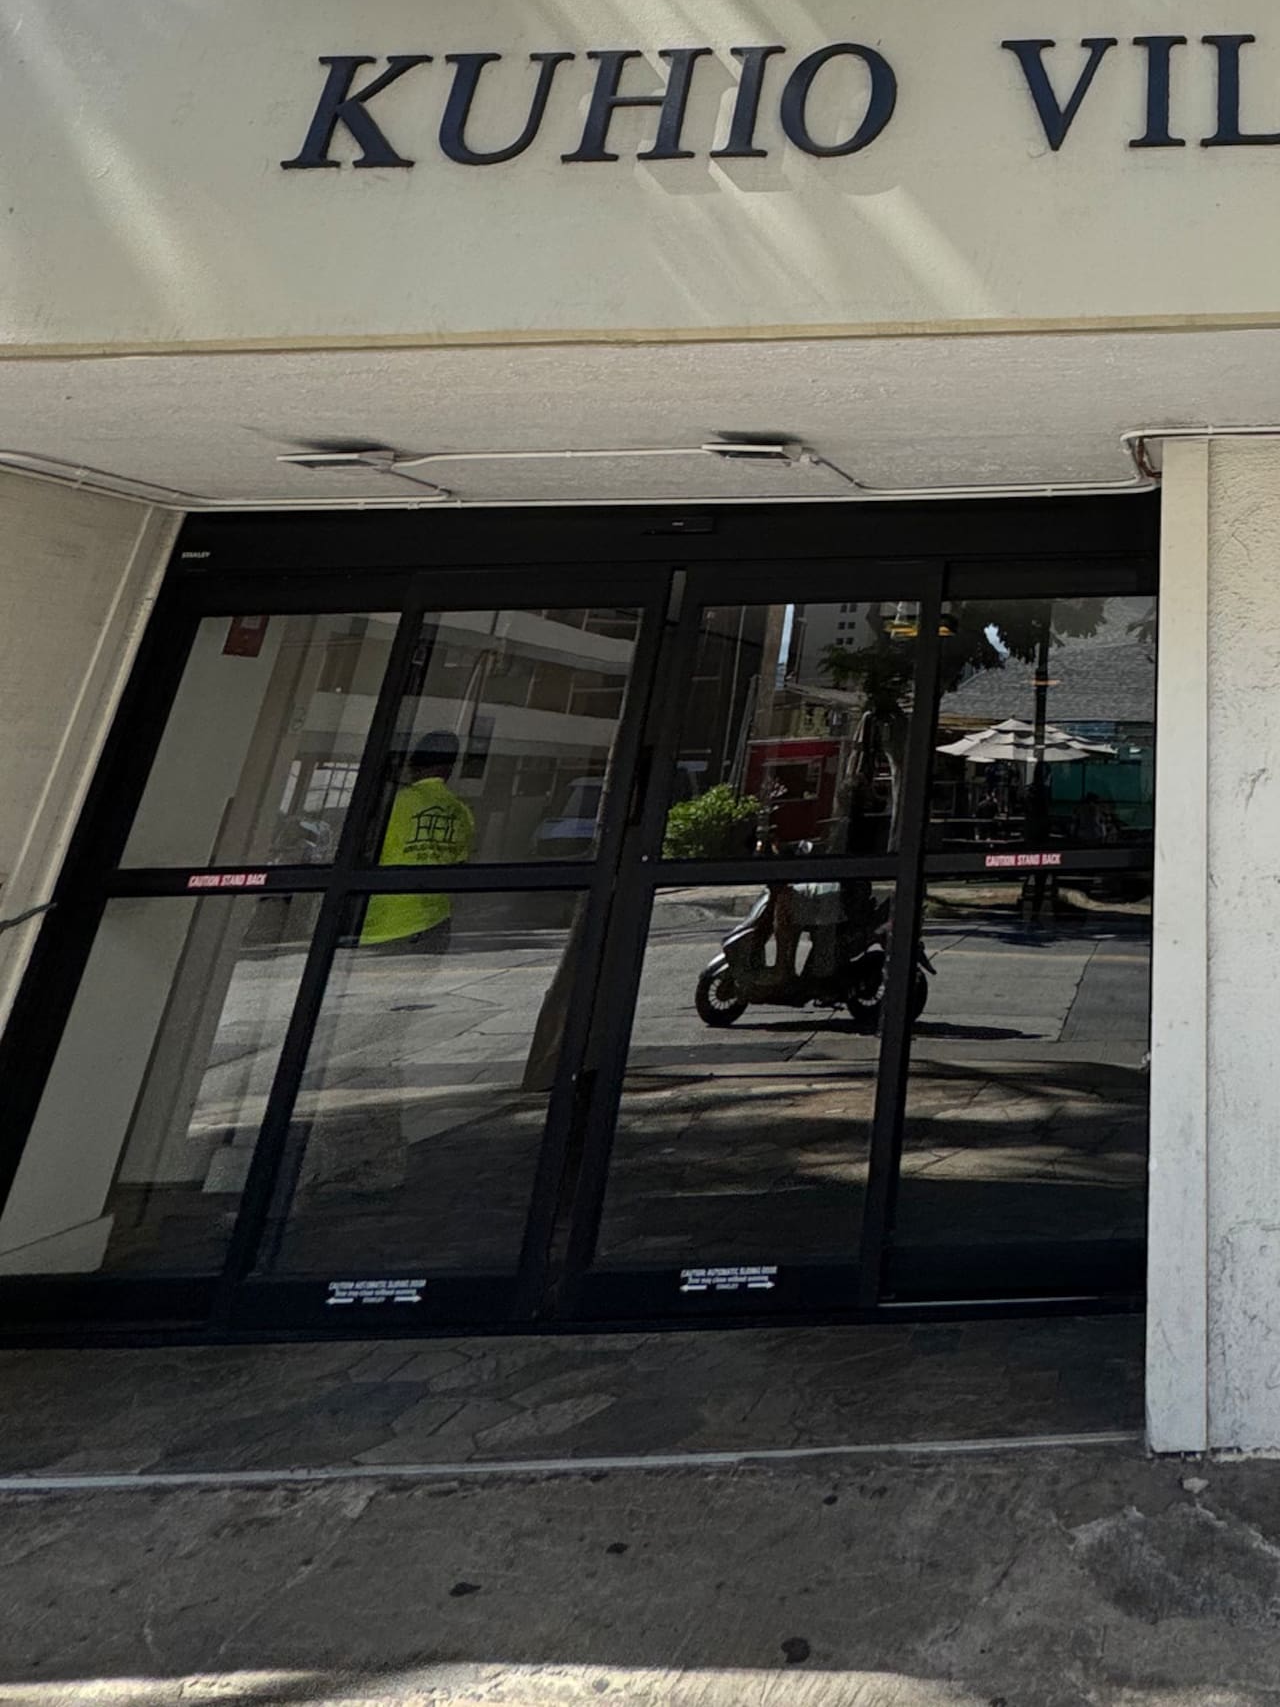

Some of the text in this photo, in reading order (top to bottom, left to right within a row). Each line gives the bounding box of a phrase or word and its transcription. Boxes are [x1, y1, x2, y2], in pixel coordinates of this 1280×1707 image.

[280, 41, 898, 170] KUHIO
[985, 853, 1061, 867] CAUTION STAND BACK
[188, 873, 267, 888] CAUTION STAND BACK
